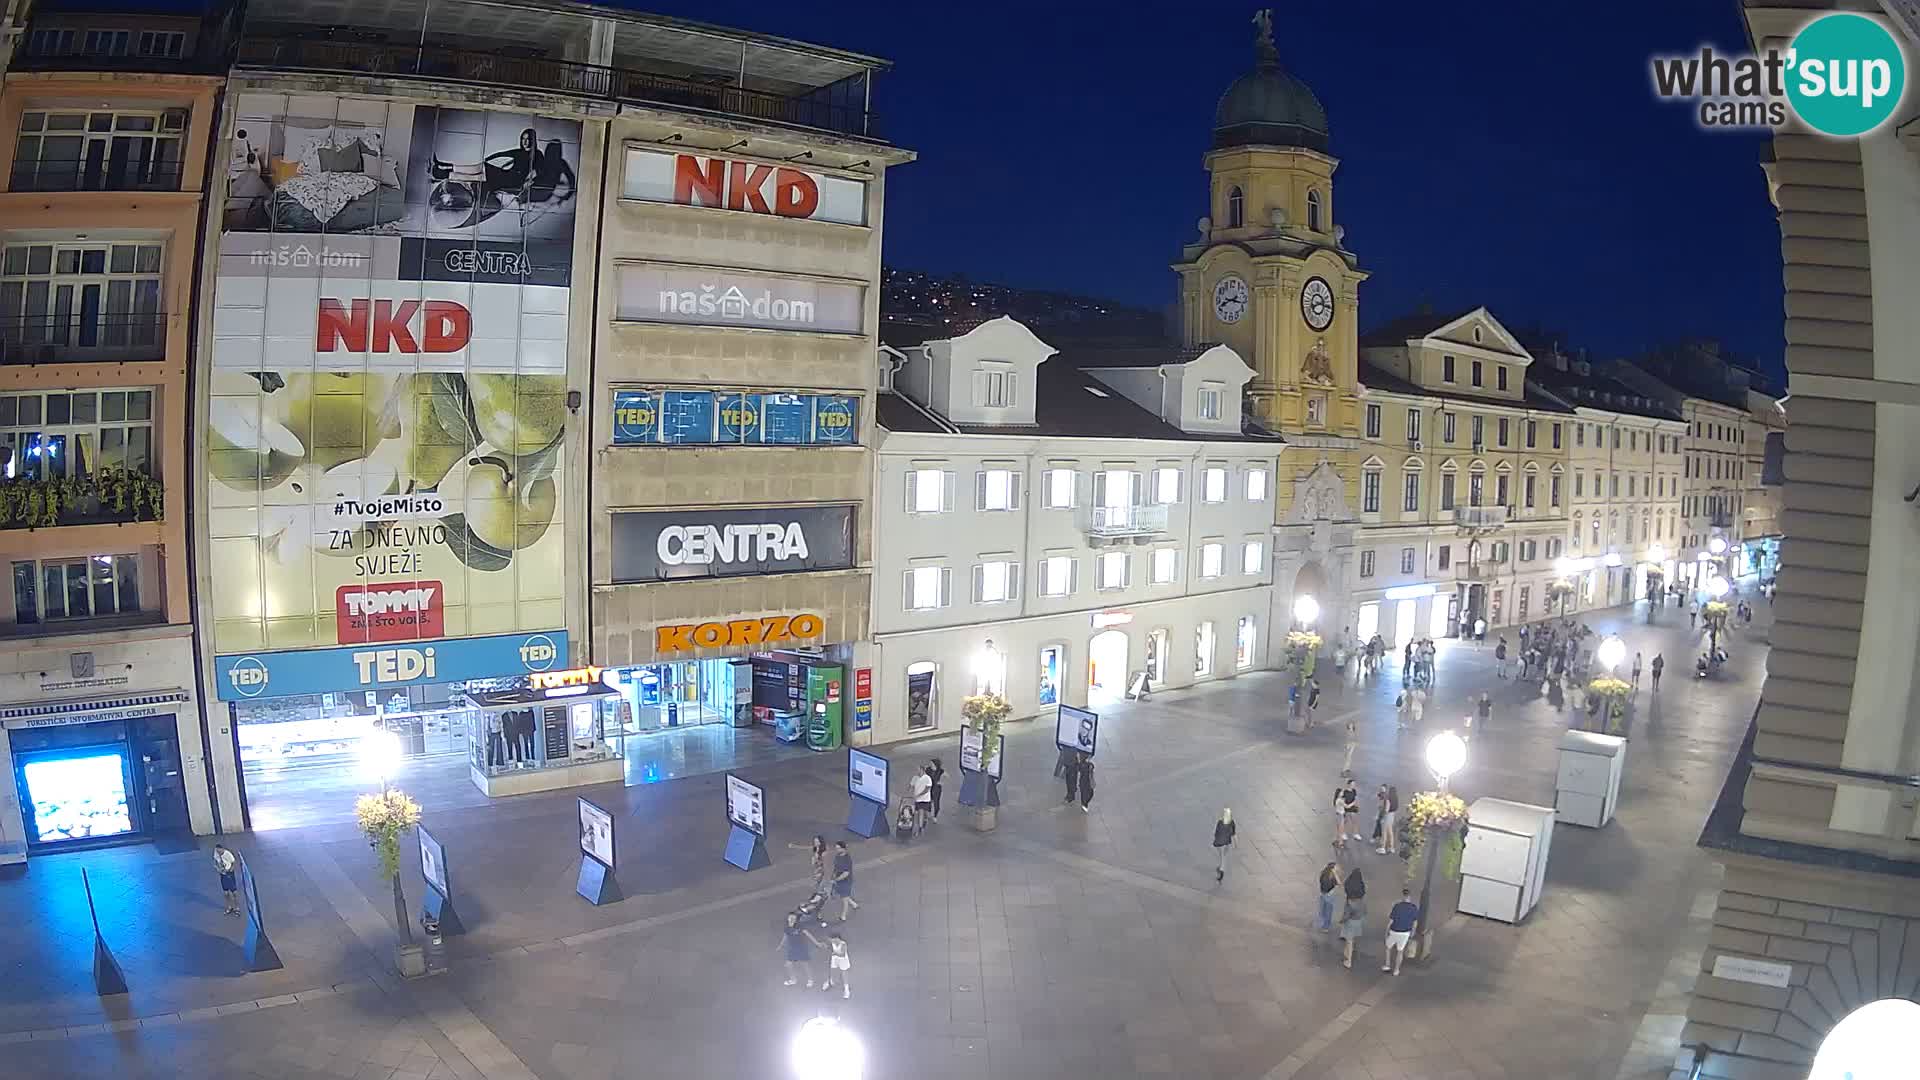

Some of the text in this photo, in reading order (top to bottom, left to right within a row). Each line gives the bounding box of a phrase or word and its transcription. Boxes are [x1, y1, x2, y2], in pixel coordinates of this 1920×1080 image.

[674, 153, 819, 219] NKD
[250, 246, 362, 268] naš dom
[445, 249, 532, 275] CENTRA
[659, 284, 816, 323] naš dom
[316, 297, 473, 354] NKD
[616, 409, 655, 425] TEDi
[721, 410, 759, 426] TEDi
[818, 412, 852, 428] TEDi
[334, 498, 443, 517] #TvojeMisto
[329, 525, 447, 550] ZA DNEVNO
[656, 521, 809, 565] CENTRA
[355, 548, 422, 576] SVJEŽE
[344, 587, 436, 616] TOMMY
[656, 613, 824, 653] KORZO
[353, 647, 436, 684] TEDi
[520, 645, 557, 663] TEDi
[228, 668, 269, 686] TEDi
[529, 665, 603, 689] TOMMY
[127, 708, 157, 718] CENTAR
